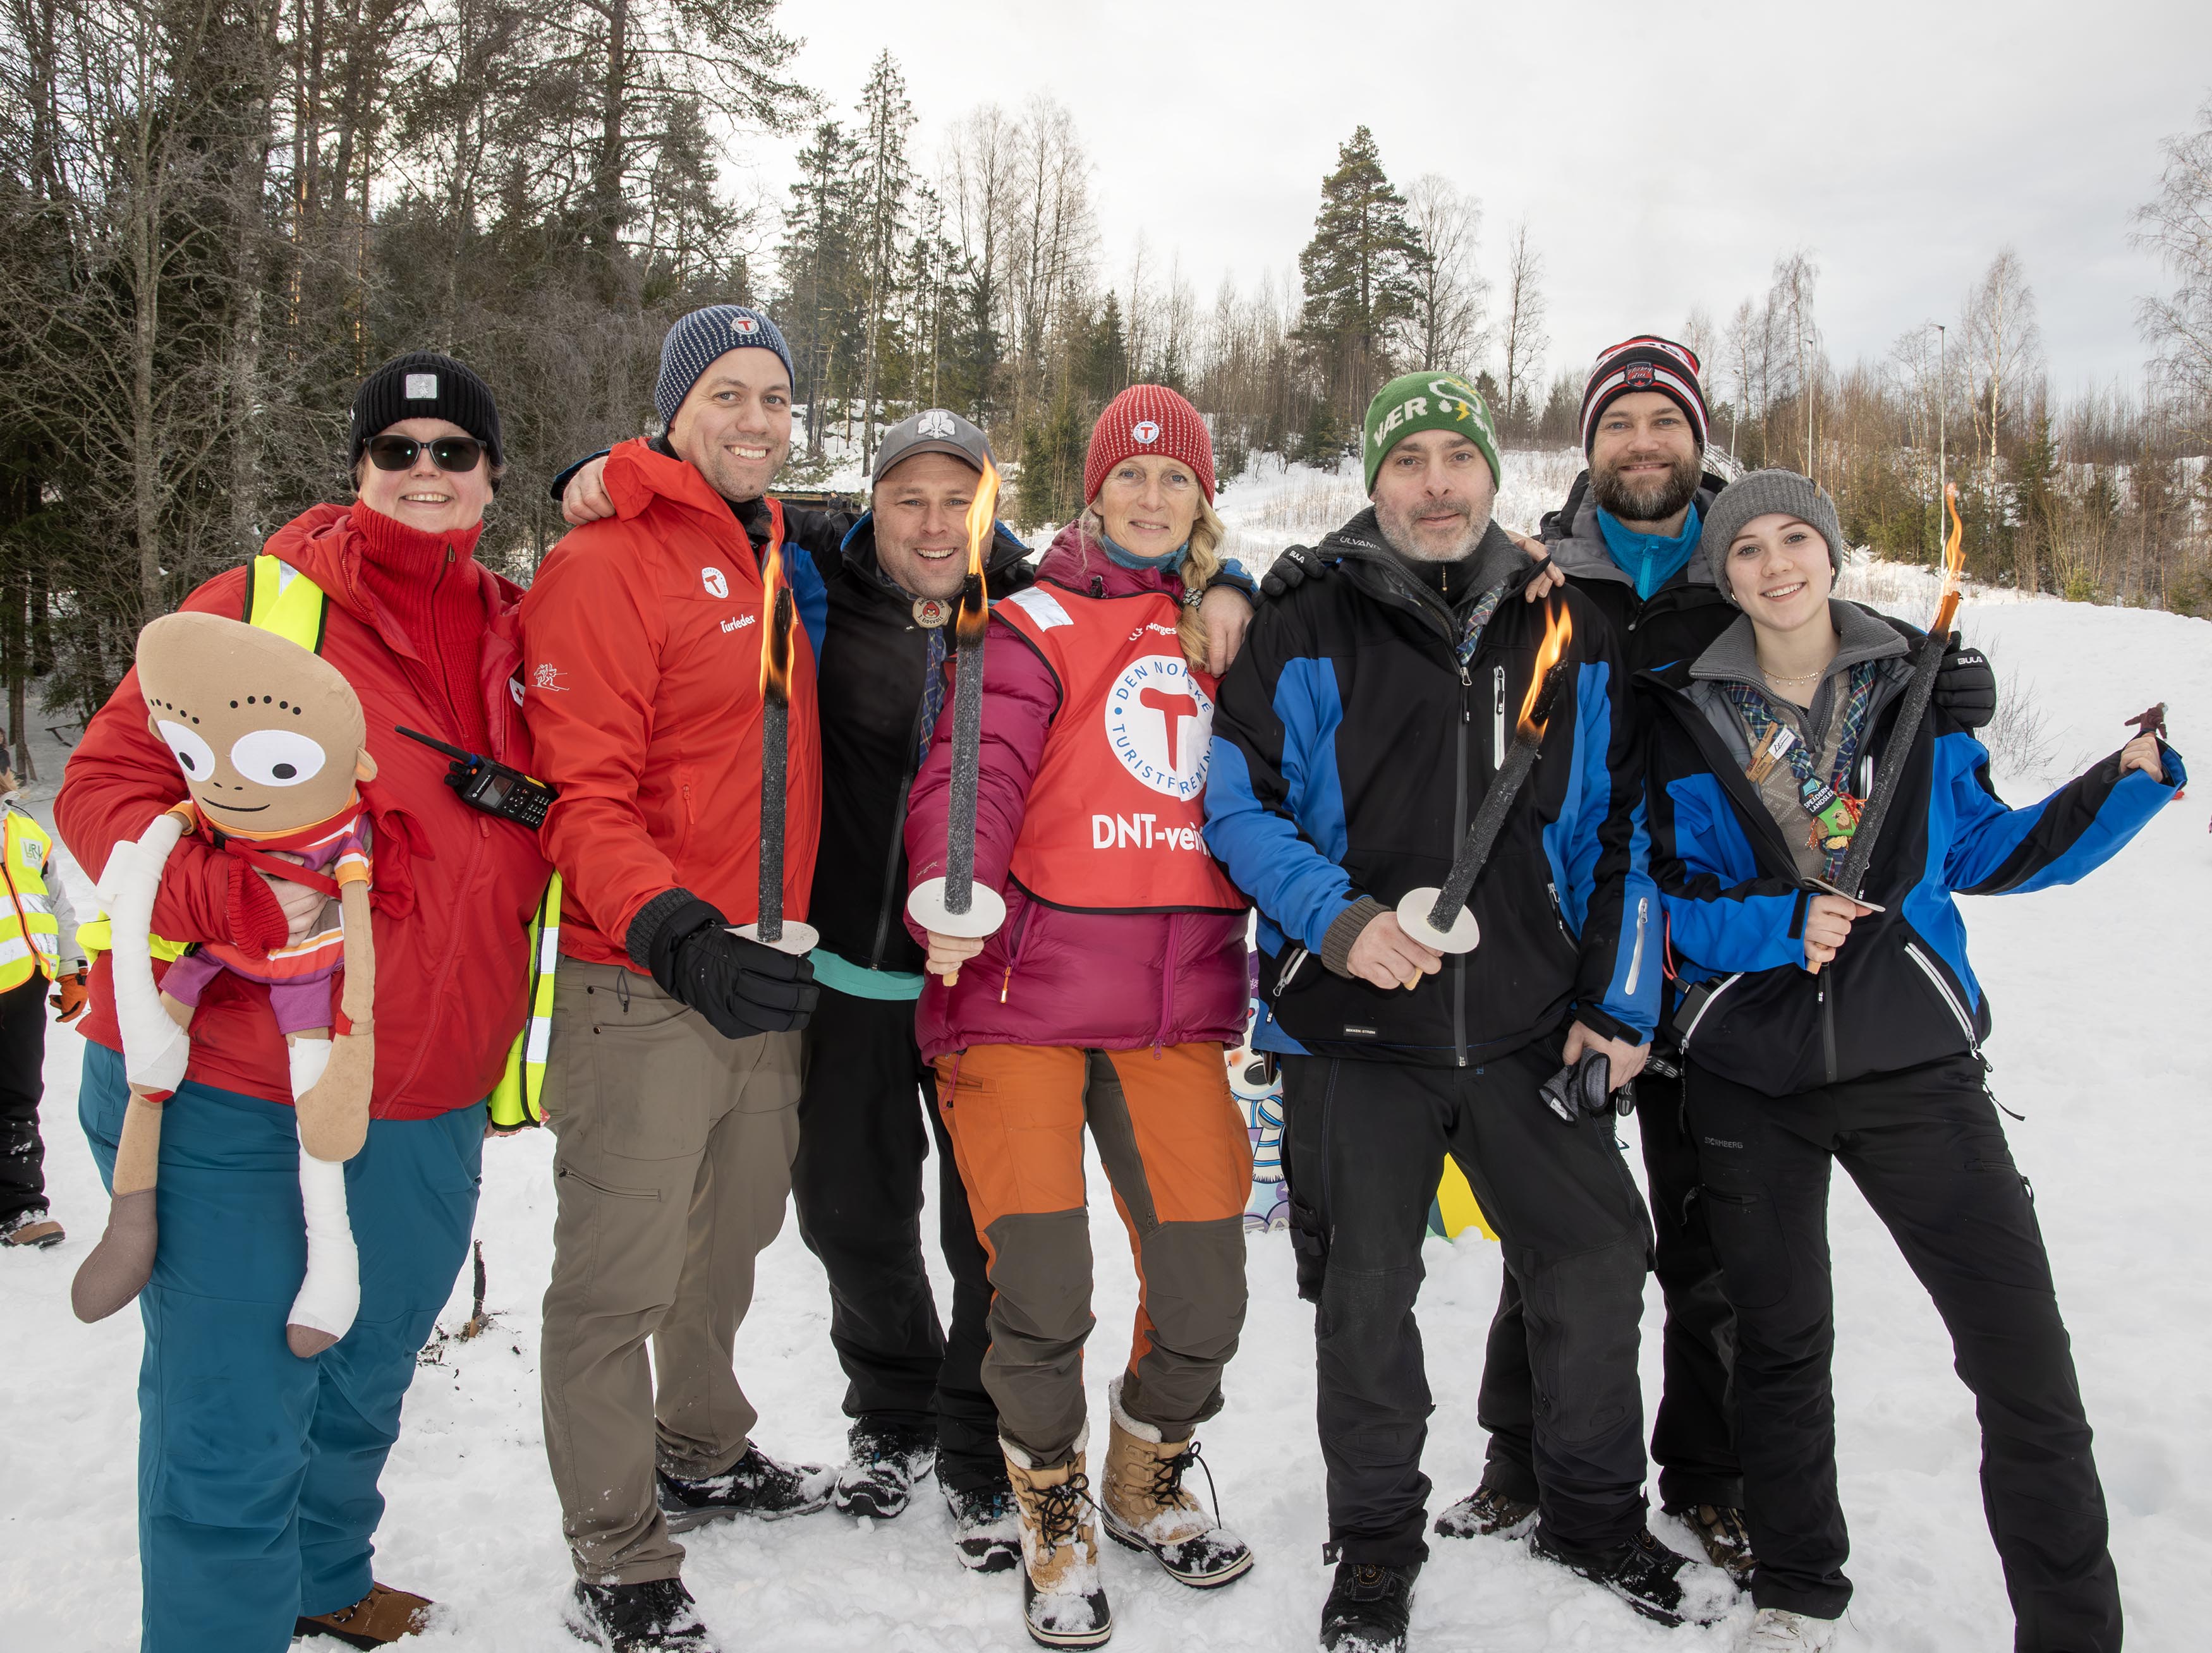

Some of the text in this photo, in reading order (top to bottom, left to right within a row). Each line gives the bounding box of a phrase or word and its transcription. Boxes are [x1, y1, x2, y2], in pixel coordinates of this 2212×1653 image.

[1373, 397, 1428, 449] VÆR
[1289, 550, 1305, 564] BULA
[720, 614, 755, 633] Turleder
[1145, 622, 1177, 636] Norges
[1957, 656, 1983, 665] BULA
[1116, 665, 1148, 700] DEN
